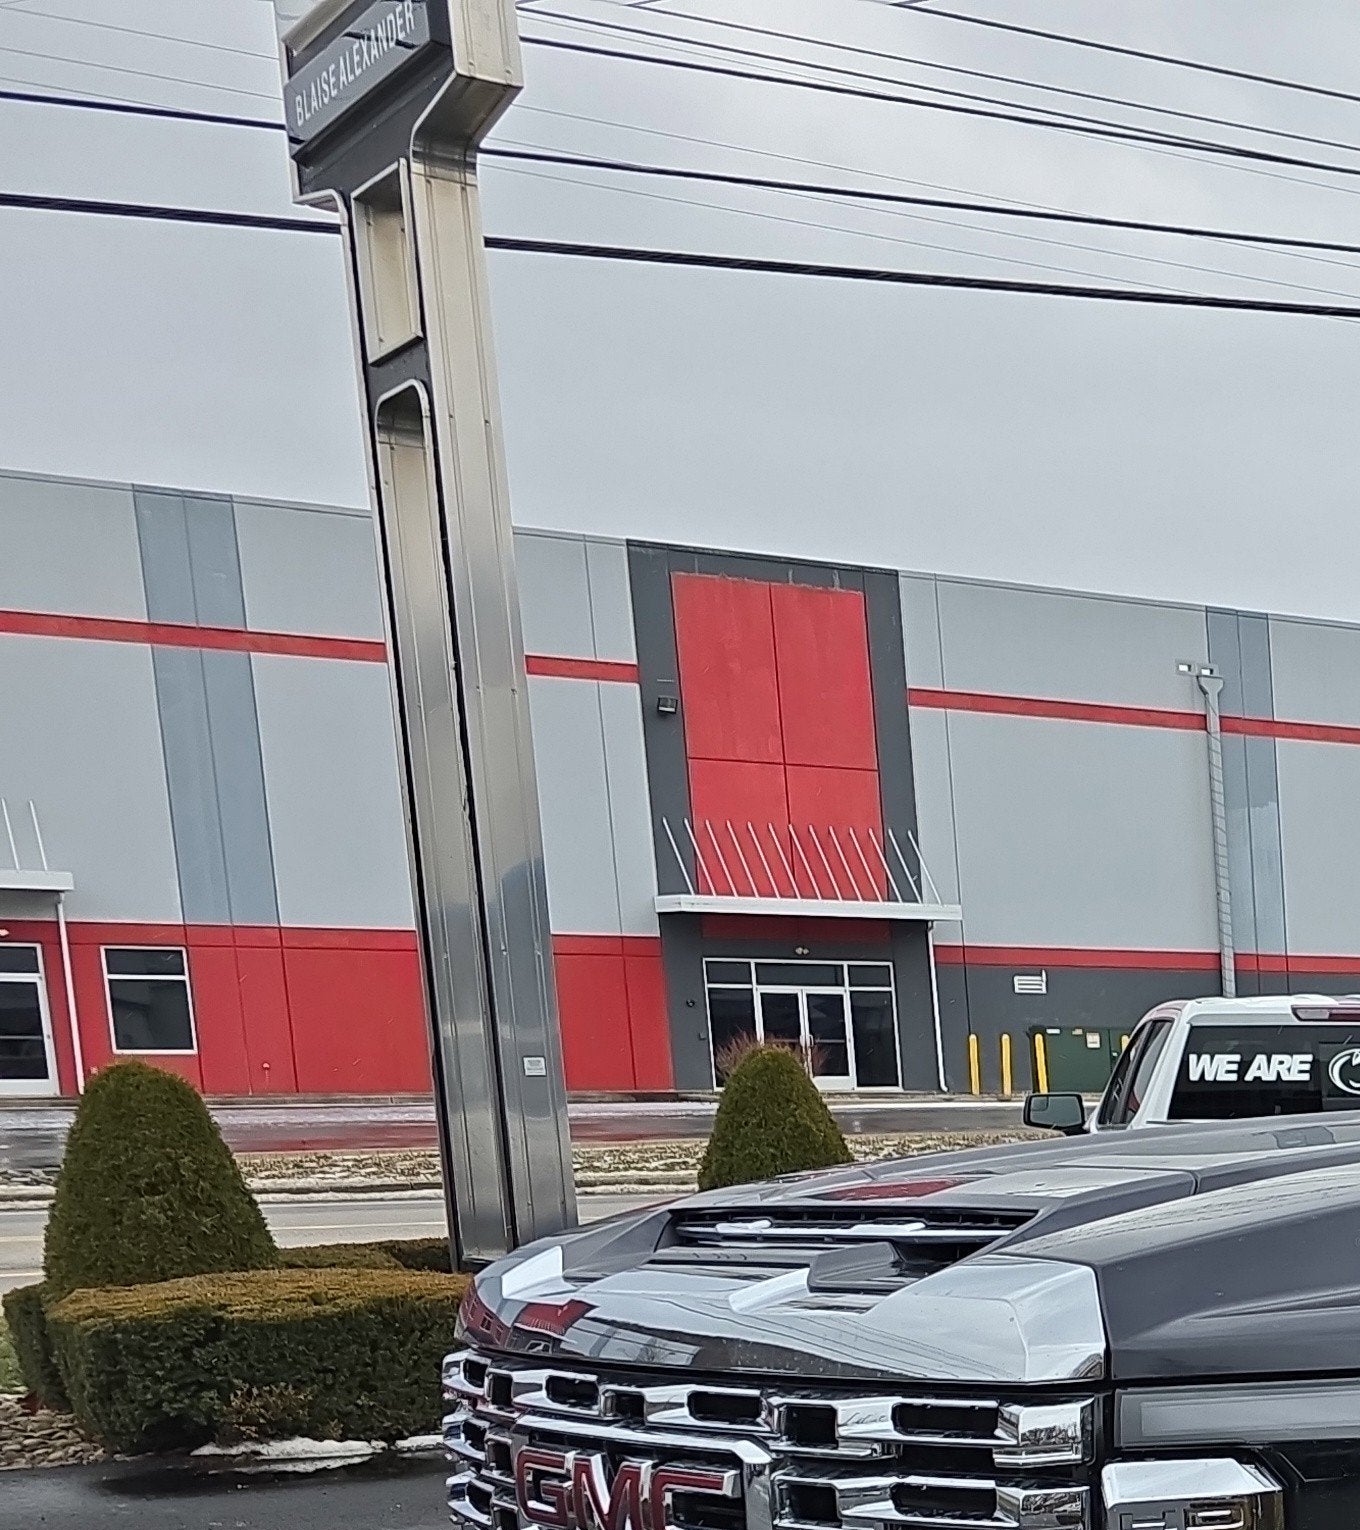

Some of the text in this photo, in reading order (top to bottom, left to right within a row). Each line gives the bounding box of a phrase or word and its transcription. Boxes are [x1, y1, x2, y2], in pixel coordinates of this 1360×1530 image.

[295, 0, 417, 127] BLAISE ALEXANDER
[1188, 1054, 1241, 1082] WE
[1244, 1053, 1315, 1082] ARE
